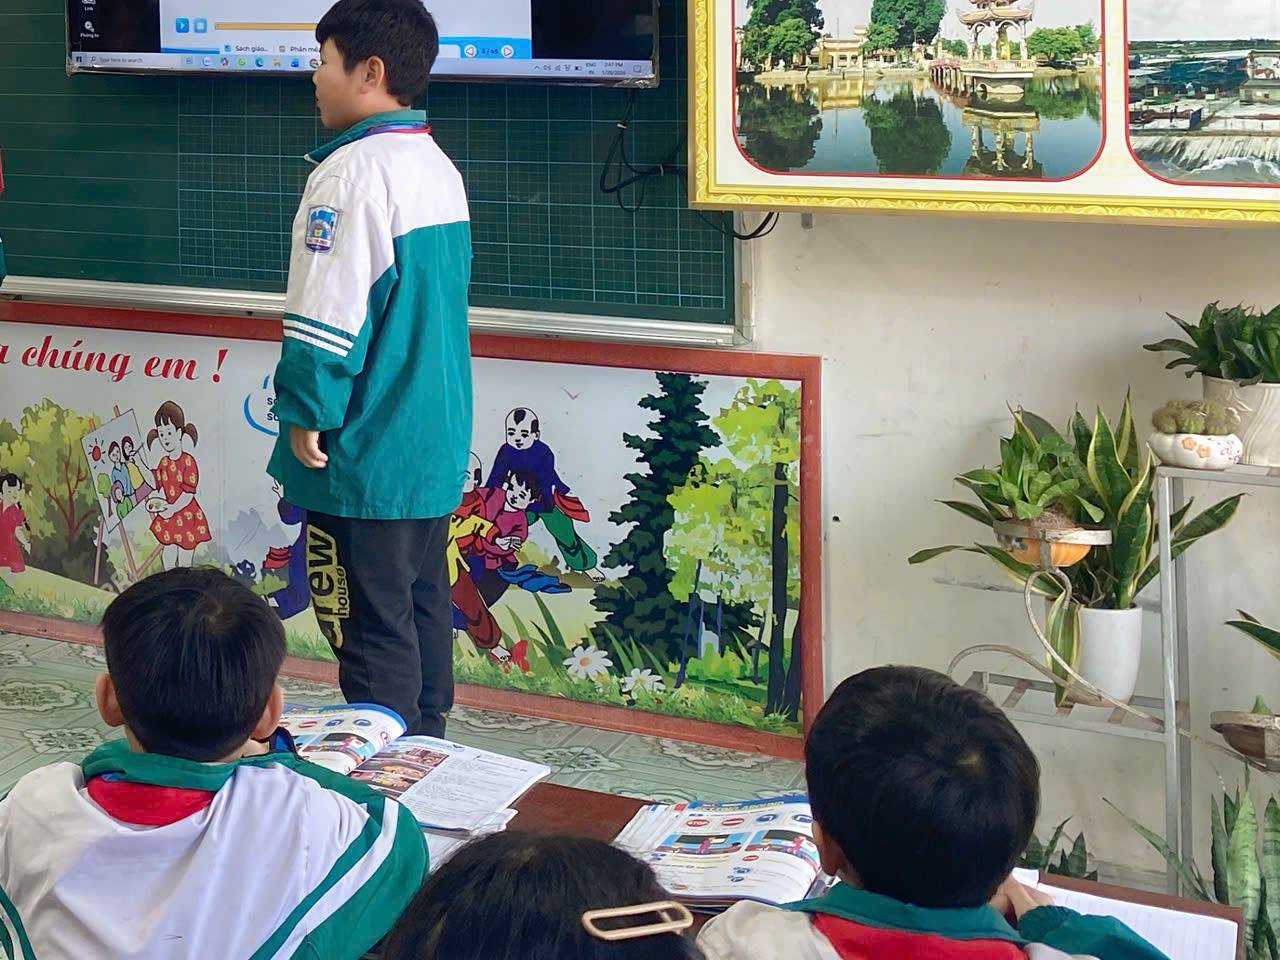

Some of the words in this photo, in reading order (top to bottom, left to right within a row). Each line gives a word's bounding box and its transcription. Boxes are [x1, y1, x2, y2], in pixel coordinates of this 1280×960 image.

[21, 332, 133, 383] chúng
[143, 358, 200, 381] em
[308, 530, 339, 645] drew
[334, 566, 348, 617] house
